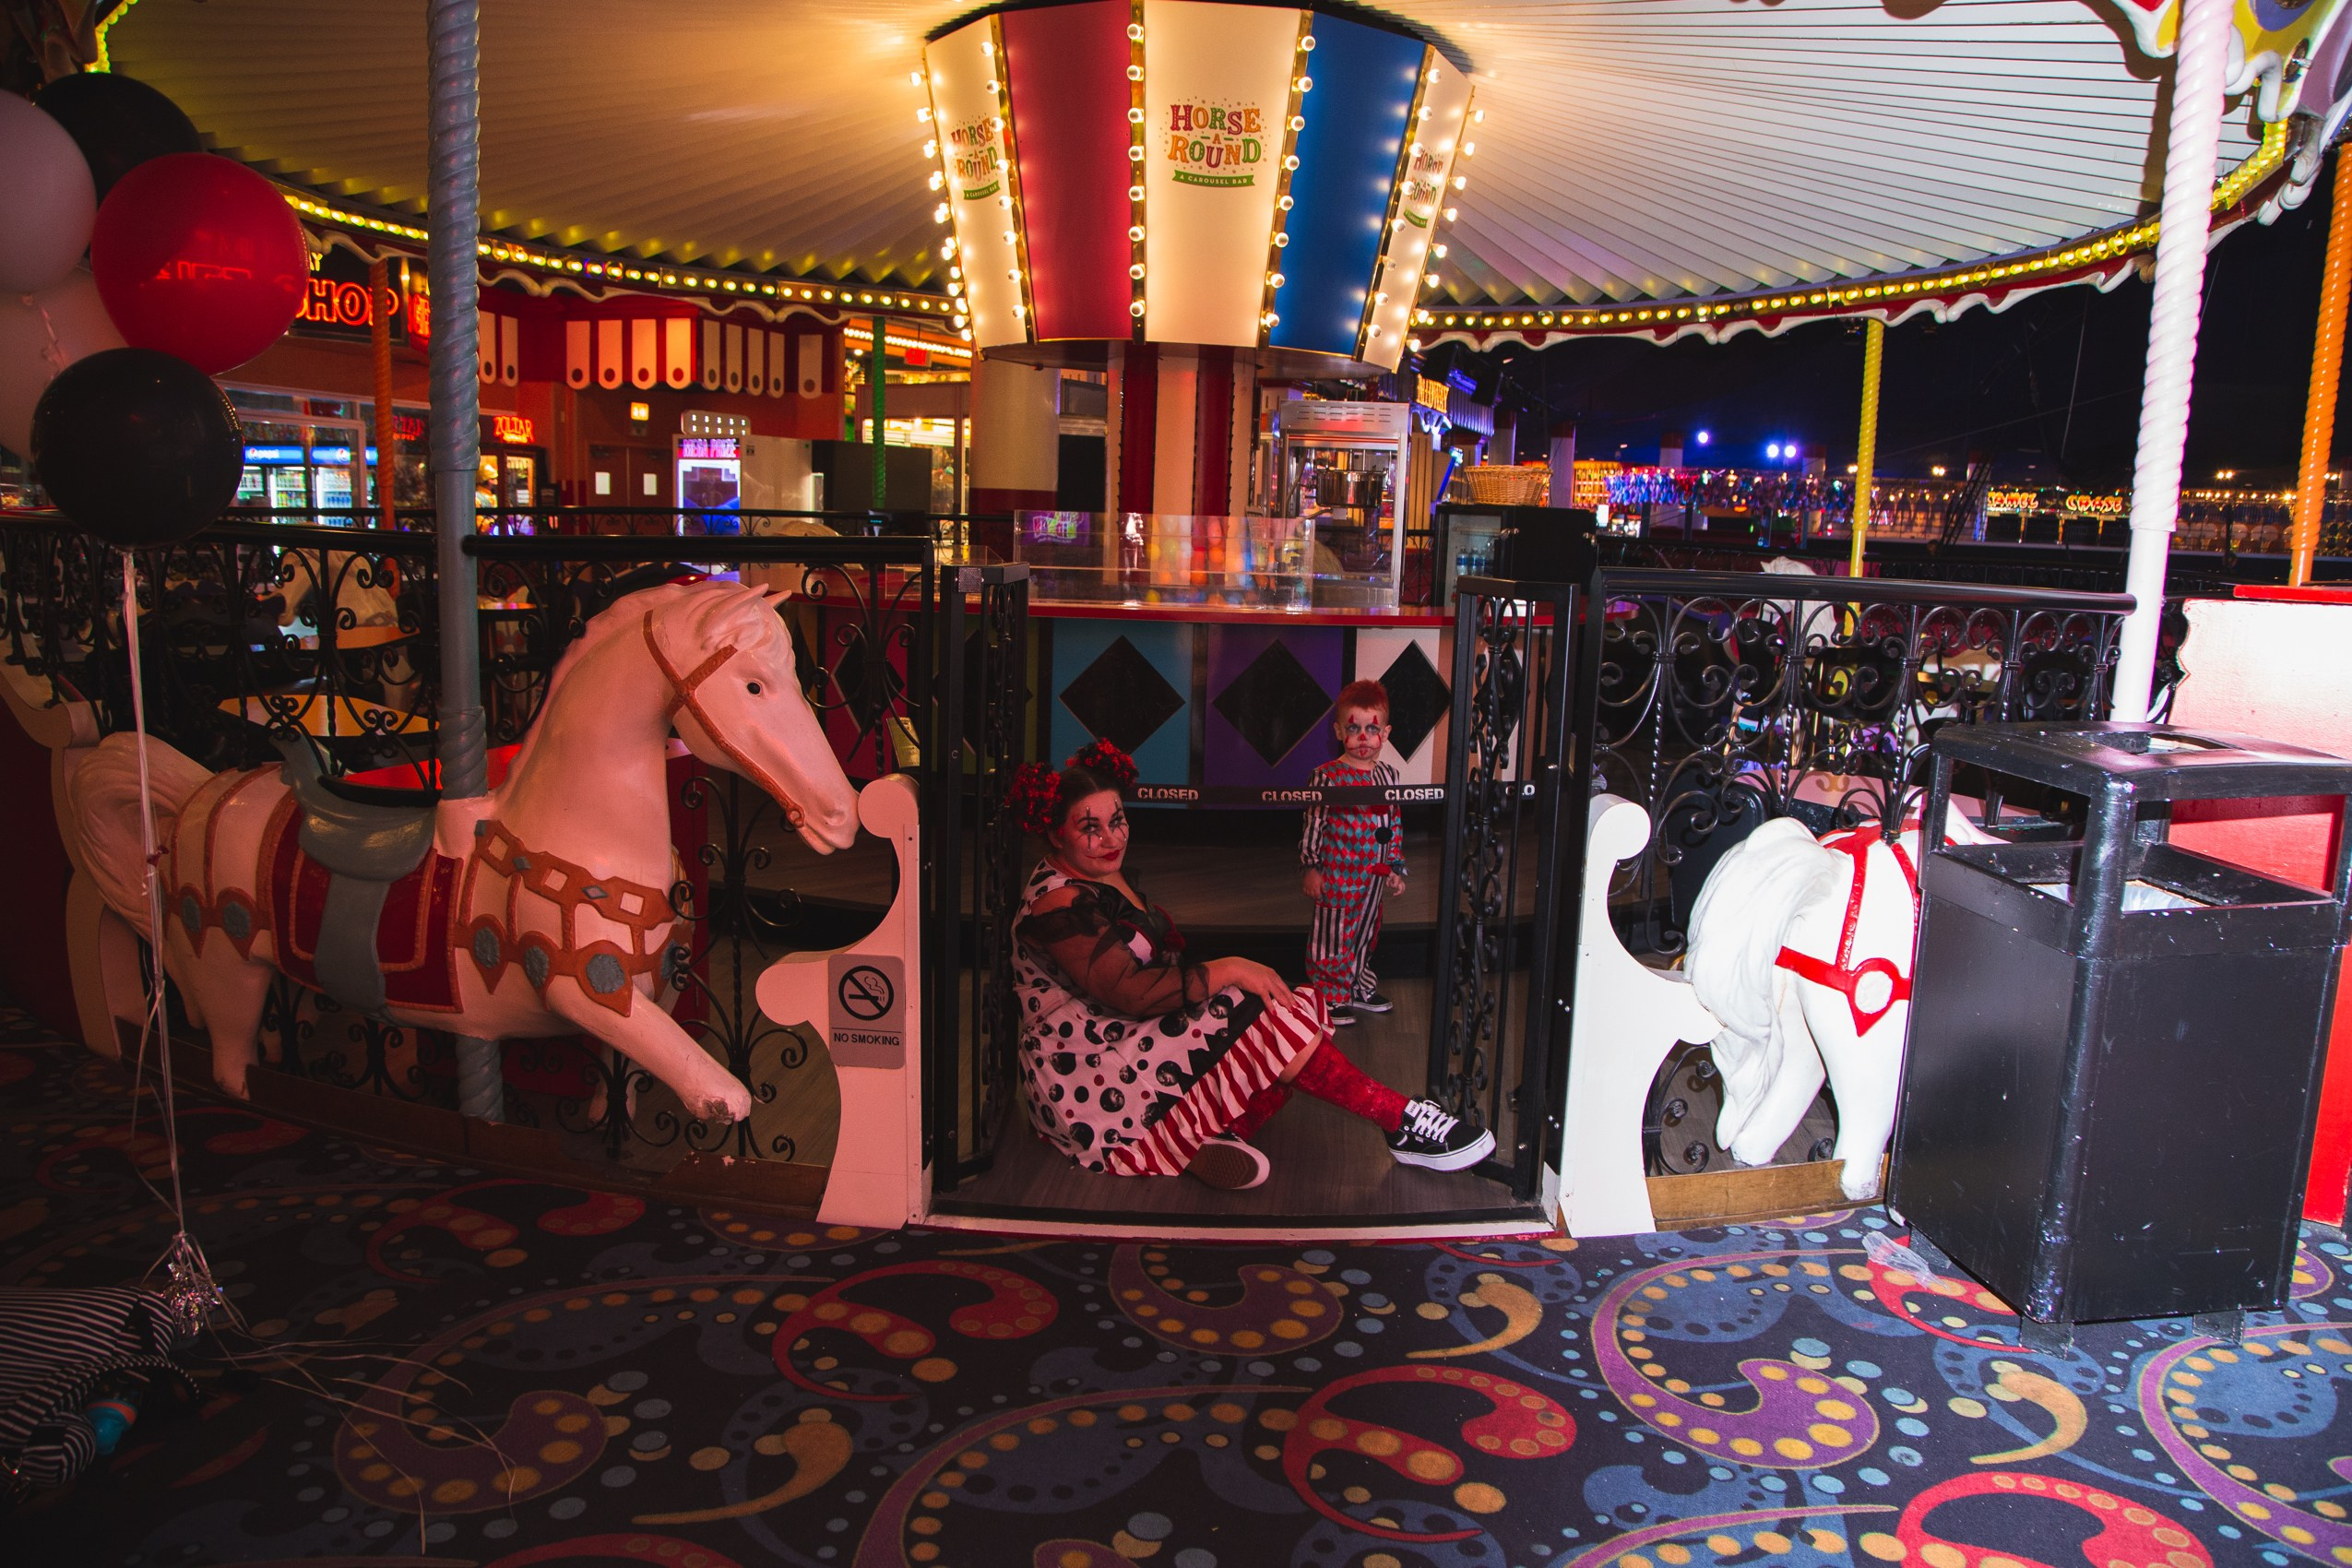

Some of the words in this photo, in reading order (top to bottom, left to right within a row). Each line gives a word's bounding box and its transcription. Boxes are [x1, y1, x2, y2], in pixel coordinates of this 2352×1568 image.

[1170, 103, 1262, 136] HORSE
[951, 117, 993, 148] HORSE
[1212, 133, 1222, 145] A
[1167, 134, 1262, 169] ROUND
[956, 146, 998, 182] ROUND
[1188, 175, 1229, 184] CAROUSEL
[493, 415, 535, 444] ZOLTAR
[683, 438, 707, 458] MEGA
[710, 438, 737, 458] PRIZE
[1987, 491, 2039, 510] CAMEL
[2065, 493, 2123, 513] CHASE
[1137, 787, 1199, 802] CLOSED
[1261, 790, 1323, 802] CLOSED
[1384, 788, 1444, 802] CLOSED
[834, 1032, 849, 1043] NO
[851, 1033, 899, 1046] SMOKING
